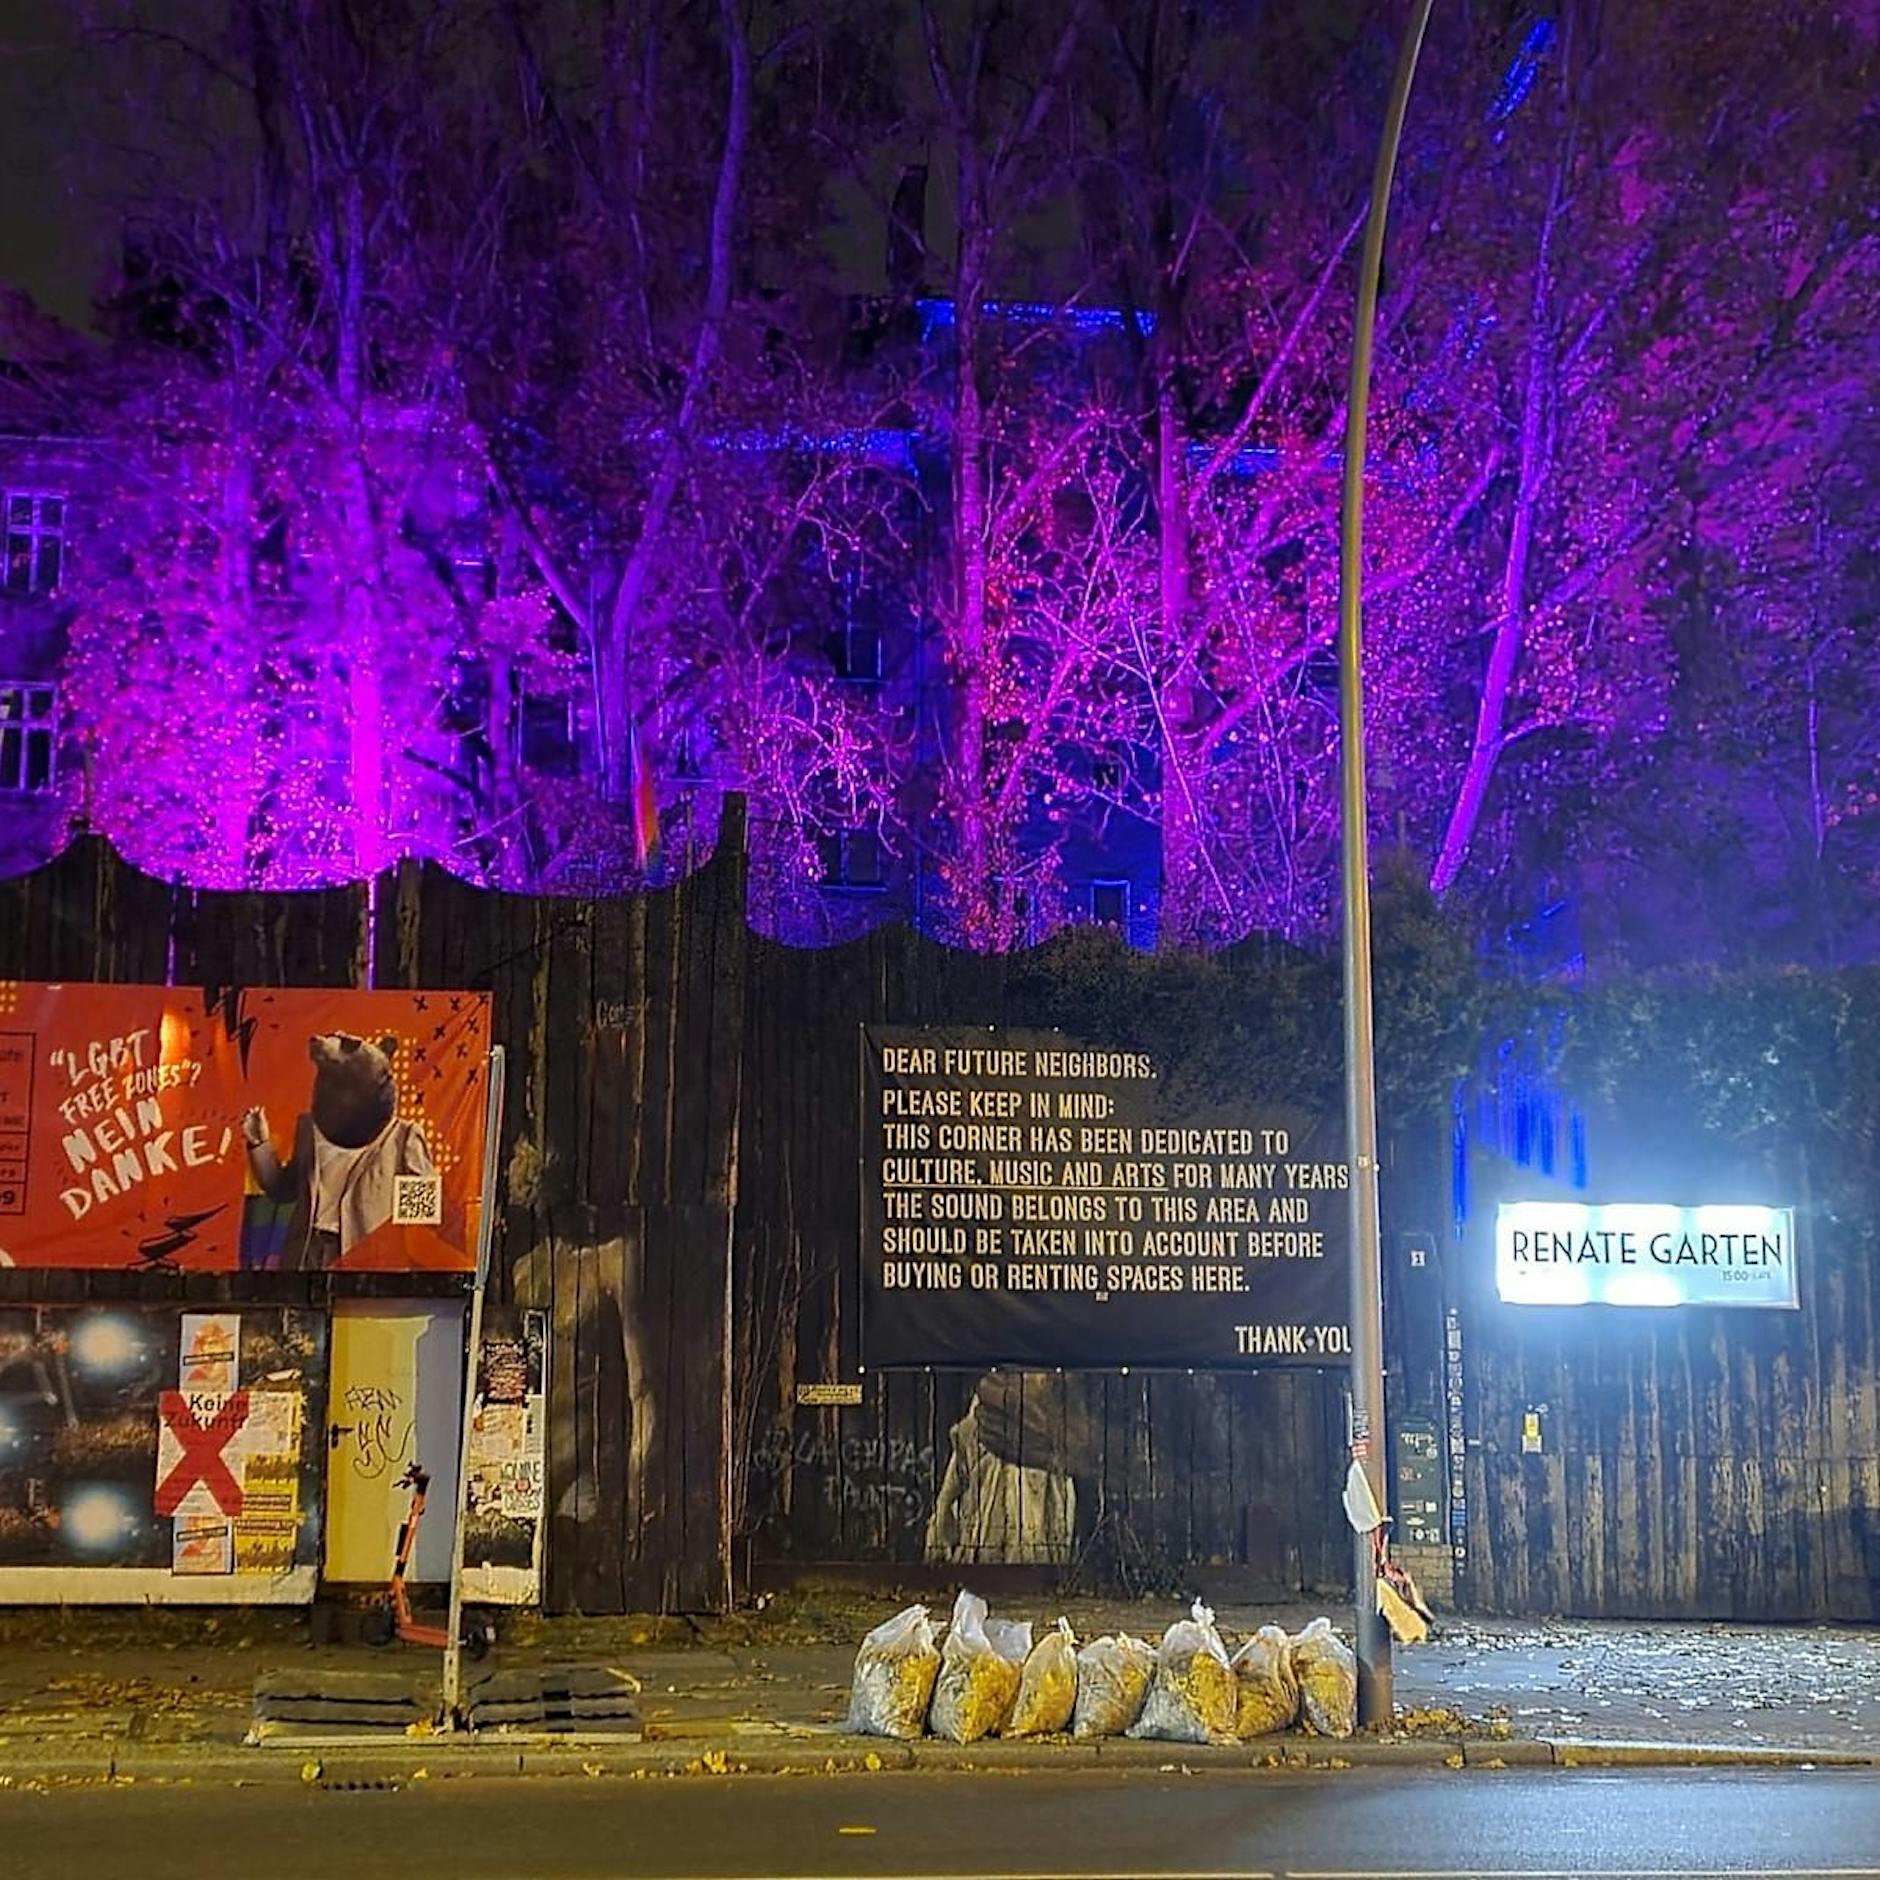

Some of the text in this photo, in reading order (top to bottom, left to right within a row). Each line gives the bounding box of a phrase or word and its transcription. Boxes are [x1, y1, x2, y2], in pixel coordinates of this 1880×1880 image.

[884, 1048, 936, 1073] DEAR
[945, 1050, 1026, 1076] FUTURE
[58, 1077, 119, 1125] FREE
[884, 1090, 1114, 1119] PLEASE KEEP IN MIND:
[61, 1096, 163, 1174] NEIN
[883, 1124, 1288, 1155] THIS CORNER HAS BEEN DEDICATED TO
[59, 1124, 232, 1221] DANKE!
[988, 1160, 1052, 1186] MUSIC
[1062, 1162, 1102, 1187] AND
[1110, 1162, 1165, 1188] ARTS
[1174, 1163, 1212, 1188] FOR
[1221, 1163, 1276, 1189] MANY
[1284, 1164, 1348, 1189] YEARS
[883, 1193, 1308, 1223] THE SOUND BELONGS TO THIS AREA AND
[884, 1228, 1323, 1257] SHOULD BE TAKEN INTO ACCOUNT BEFORE
[1512, 1230, 1783, 1267] RENATE GARTEN
[884, 1262, 1249, 1292] BUYING OR RENTING SPACES HERE.
[1235, 1326, 1309, 1353] THANK
